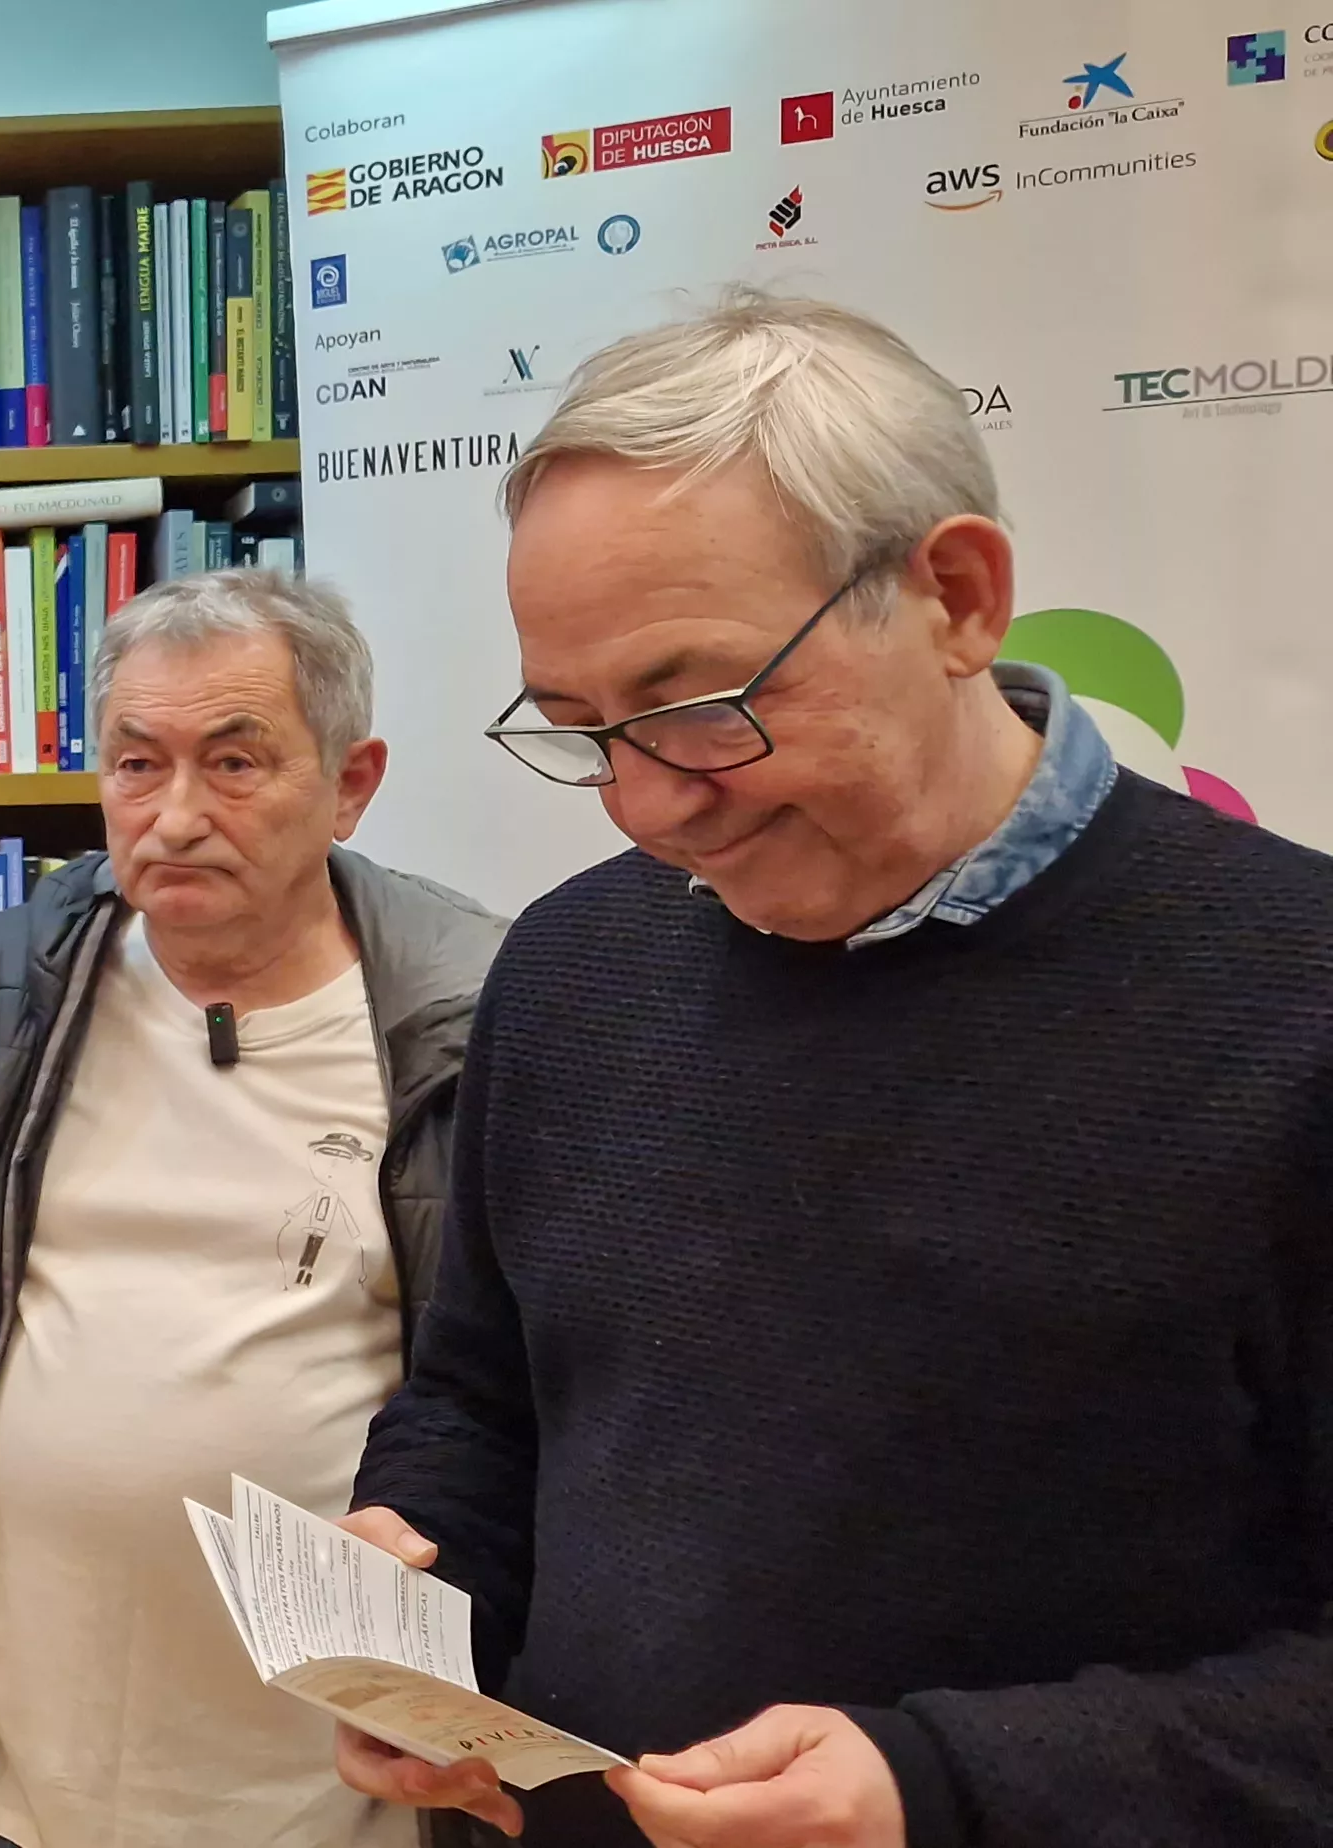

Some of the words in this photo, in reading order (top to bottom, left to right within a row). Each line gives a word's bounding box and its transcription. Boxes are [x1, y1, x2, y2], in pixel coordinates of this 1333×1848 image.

[841, 70, 981, 106] Ayuntamiento
[304, 111, 406, 144] Colaboran
[841, 107, 865, 126] de
[871, 96, 947, 121] Huesca
[1018, 114, 1105, 139] Fundación
[1108, 109, 1129, 126] "la
[1131, 101, 1186, 123] Caixa"
[601, 115, 713, 147] DIPUTACIÓN
[349, 146, 485, 185] GOBIERNO
[602, 147, 627, 166] DE
[633, 136, 712, 161] HUESCA
[350, 186, 382, 210] DE
[392, 166, 505, 203] ARAGON
[925, 163, 1001, 195] aws
[1015, 148, 1197, 191] InCommunities
[136, 206, 151, 253] MADRE
[484, 225, 580, 252] AGROPAL
[137, 257, 151, 312] LENGUA
[314, 328, 382, 352] Apoyan
[316, 377, 386, 405] CDAN
[1114, 356, 1333, 404] TECMOLD
[318, 432, 521, 483] BUENAVENTURA
[272, 1501, 286, 1572] PICASSIANOS
[278, 1574, 295, 1628] RETRATOS
[419, 1591, 431, 1651] PLÁSTICAS
